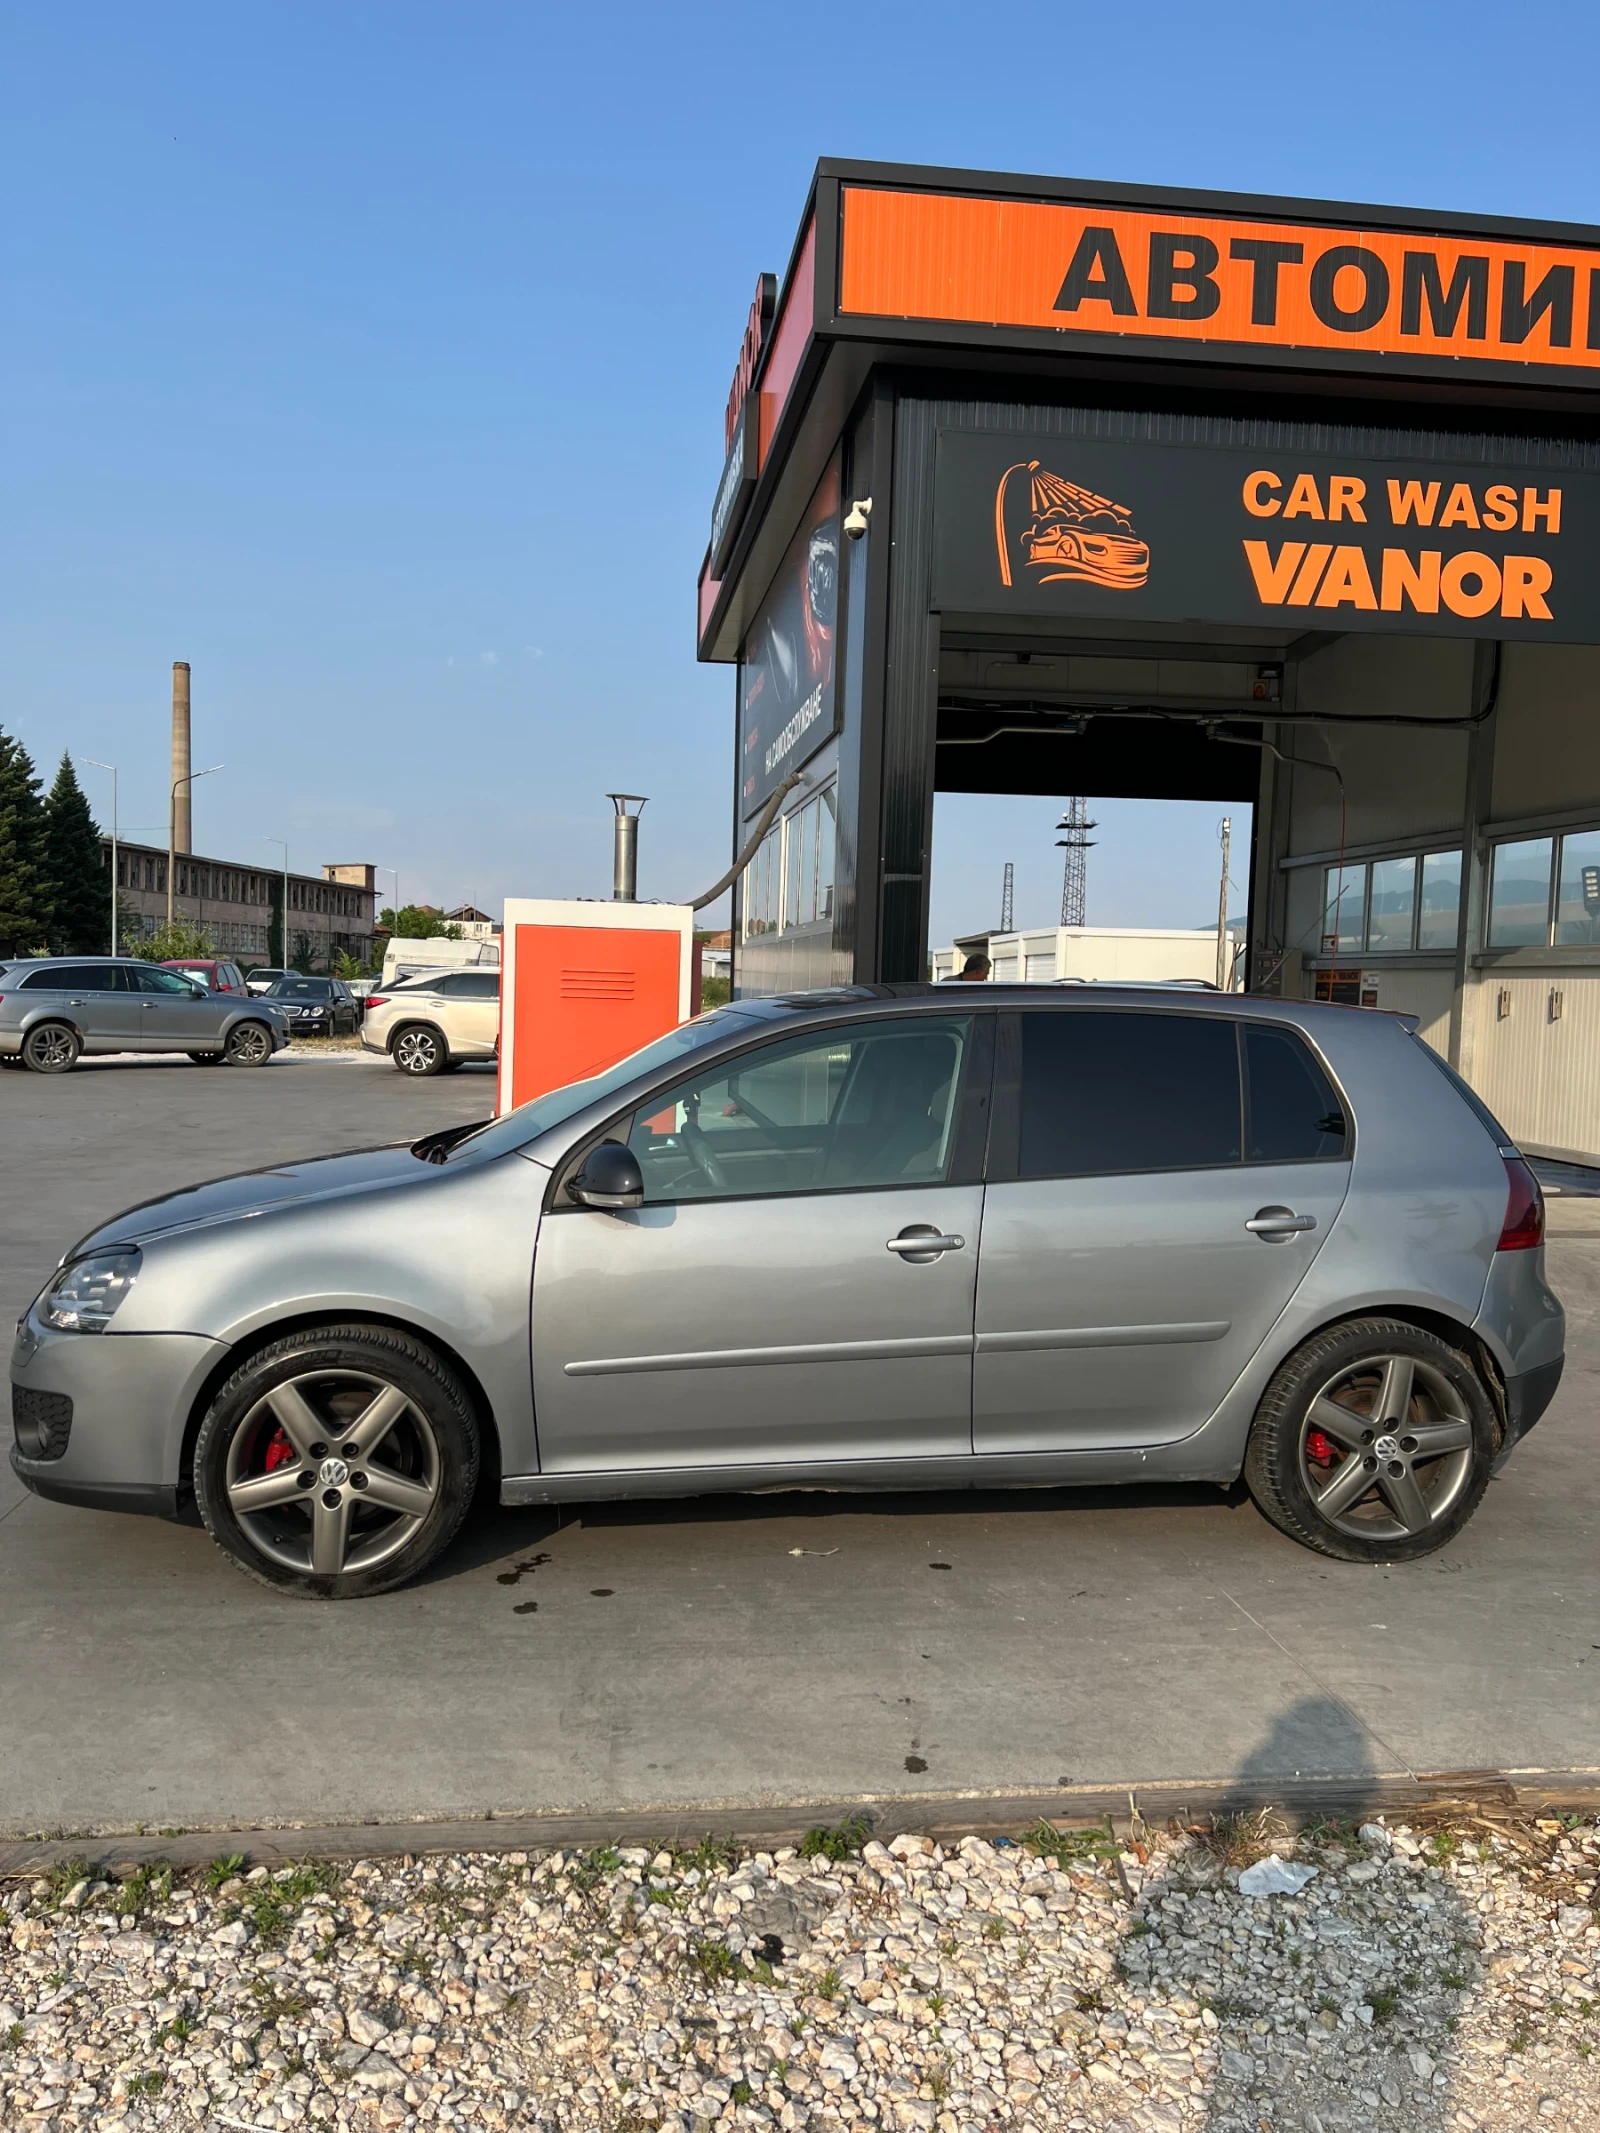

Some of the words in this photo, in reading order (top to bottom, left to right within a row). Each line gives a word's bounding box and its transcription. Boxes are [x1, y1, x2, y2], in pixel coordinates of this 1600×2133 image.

[1052, 225, 1600, 351] АВТОМИ
[1242, 470, 1367, 523] CAR
[1386, 479, 1562, 533] WASH
[1242, 540, 1554, 619] VIANOR
